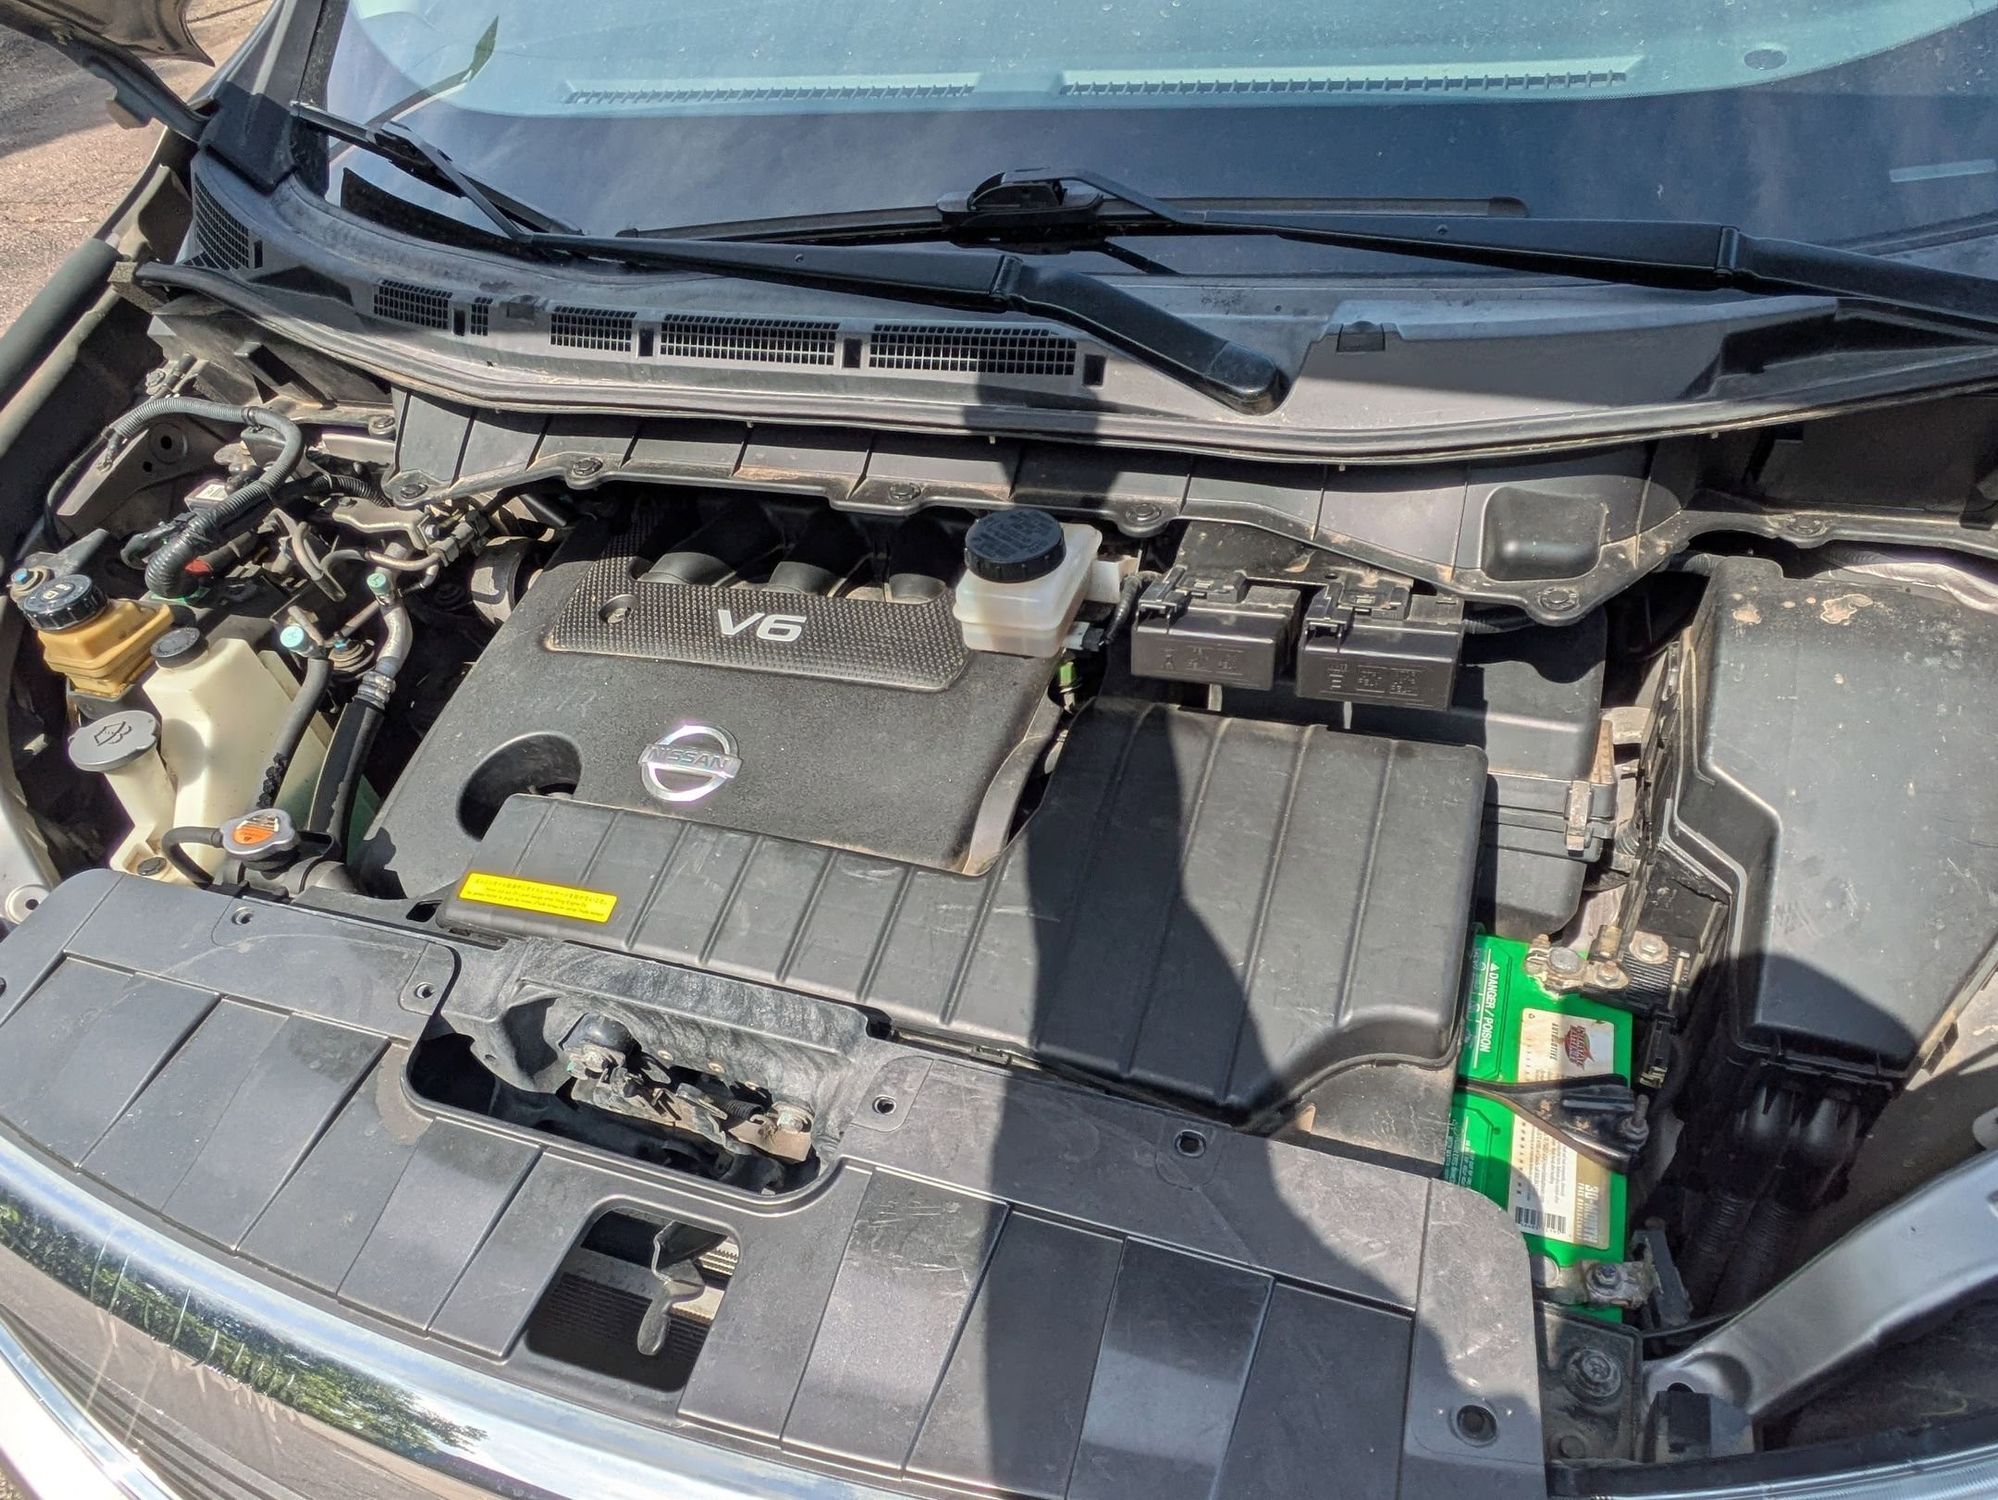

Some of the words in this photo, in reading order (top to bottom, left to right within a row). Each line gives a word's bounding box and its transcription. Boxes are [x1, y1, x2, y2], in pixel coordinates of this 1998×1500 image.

[717, 609, 807, 642] V6
[650, 746, 729, 768] NISSAN
[1485, 973, 1499, 1009] DANGER
[1479, 1017, 1494, 1053] POISON
